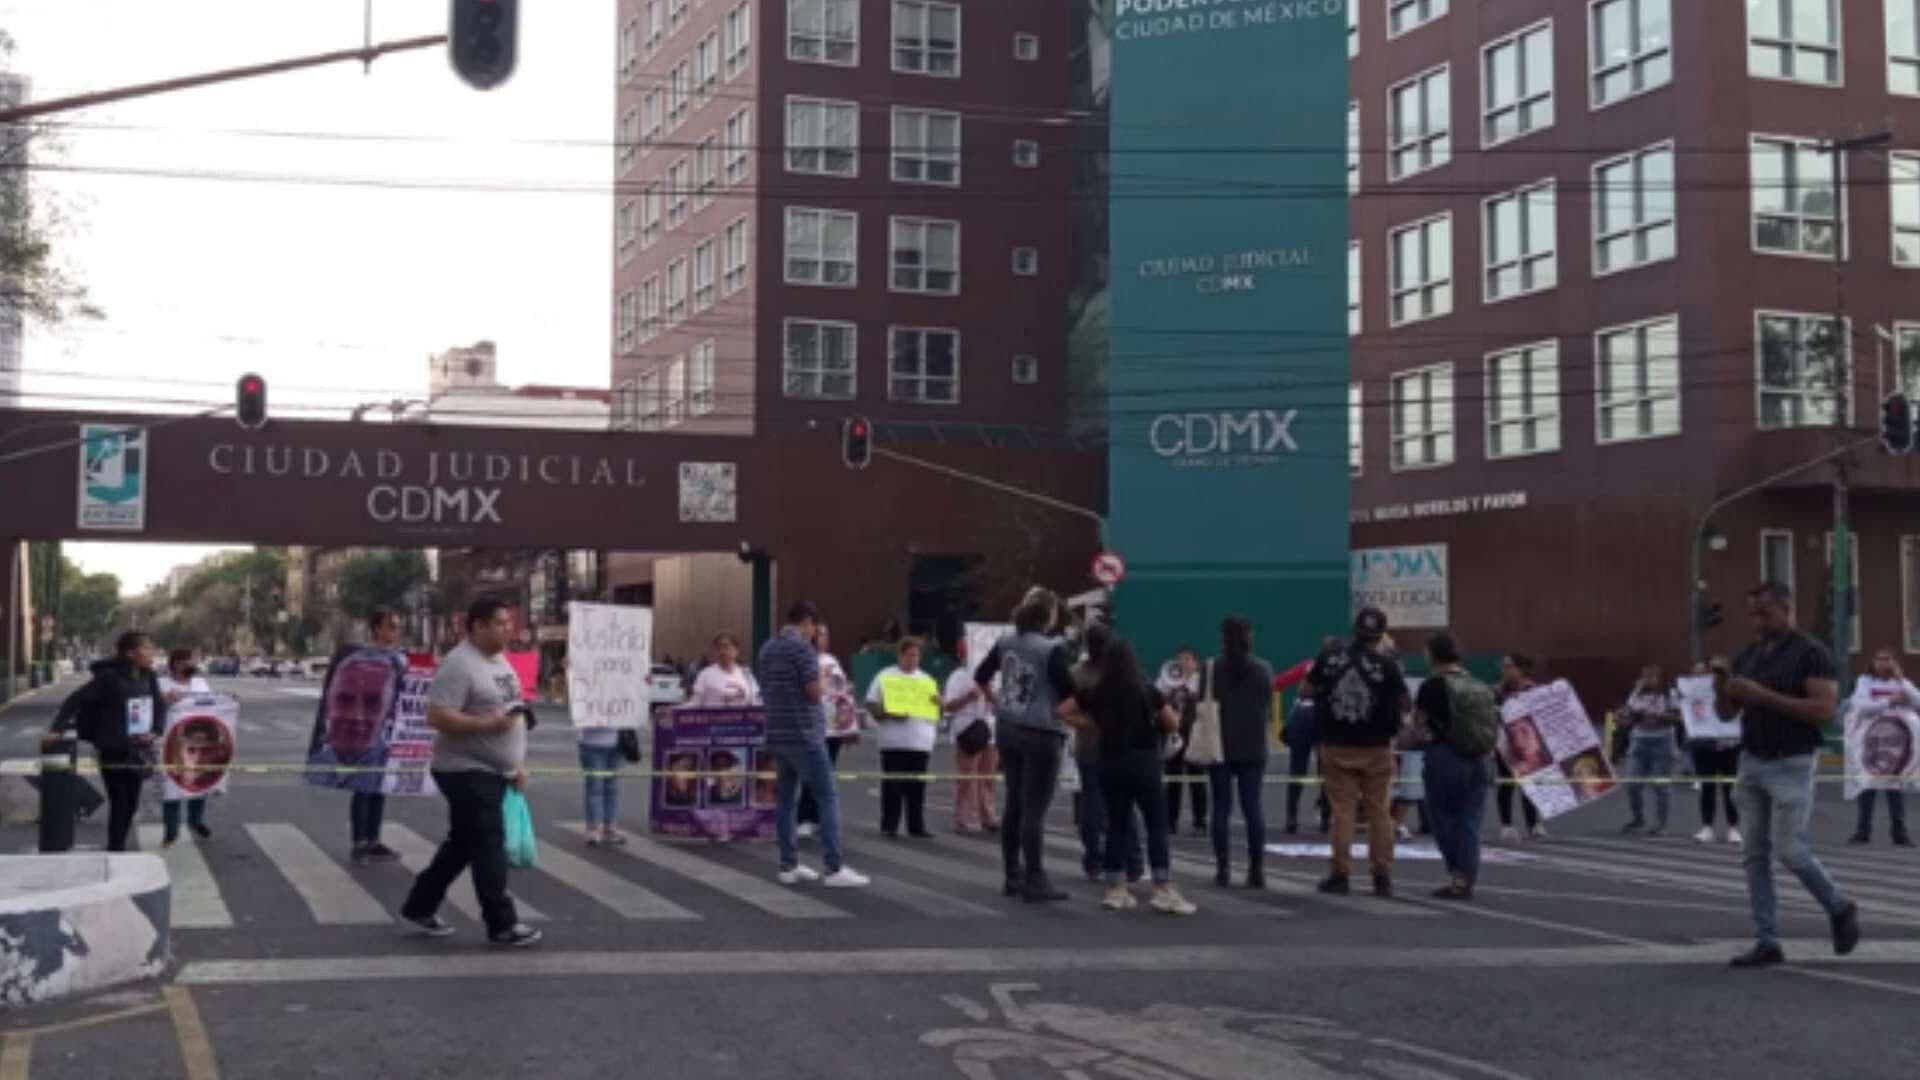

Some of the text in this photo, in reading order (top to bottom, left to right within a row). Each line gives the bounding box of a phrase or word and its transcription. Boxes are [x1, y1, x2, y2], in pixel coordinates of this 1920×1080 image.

[1116, 14, 1203, 40] CIUDAD
[1209, 10, 1236, 30] DE
[1139, 256, 1215, 277] CIUDAD
[1195, 272, 1256, 293] CDMX
[1151, 409, 1299, 456] CDMX
[208, 443, 647, 487] CIUDAD JUDICIAL
[366, 485, 503, 523] CDMX
[575, 606, 647, 651] Justicia
